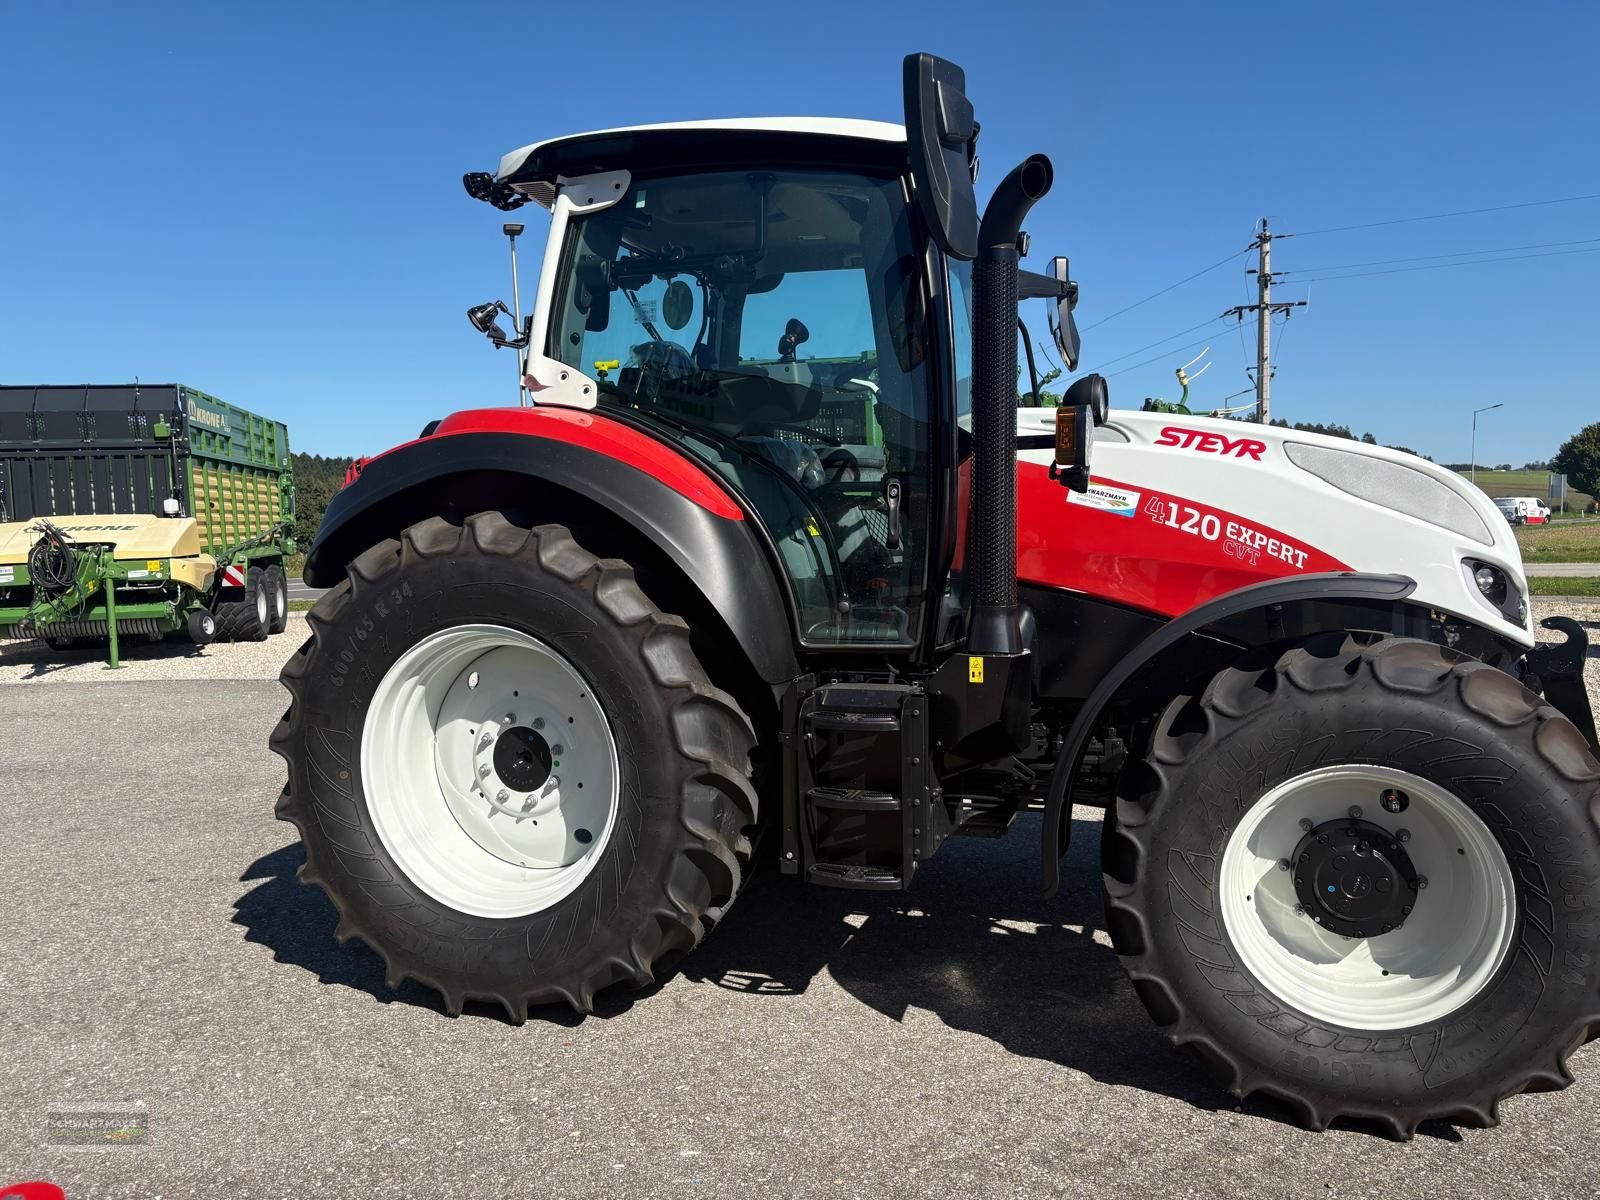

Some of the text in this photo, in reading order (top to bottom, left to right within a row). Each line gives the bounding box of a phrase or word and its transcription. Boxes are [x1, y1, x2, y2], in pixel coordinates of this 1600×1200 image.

[197, 407, 220, 428] KRONE
[1154, 426, 1266, 461] STEYR
[1144, 496, 1308, 569] 4120 EXPERT
[1223, 539, 1260, 566] CVT
[329, 581, 415, 687] 600/65 R 34
